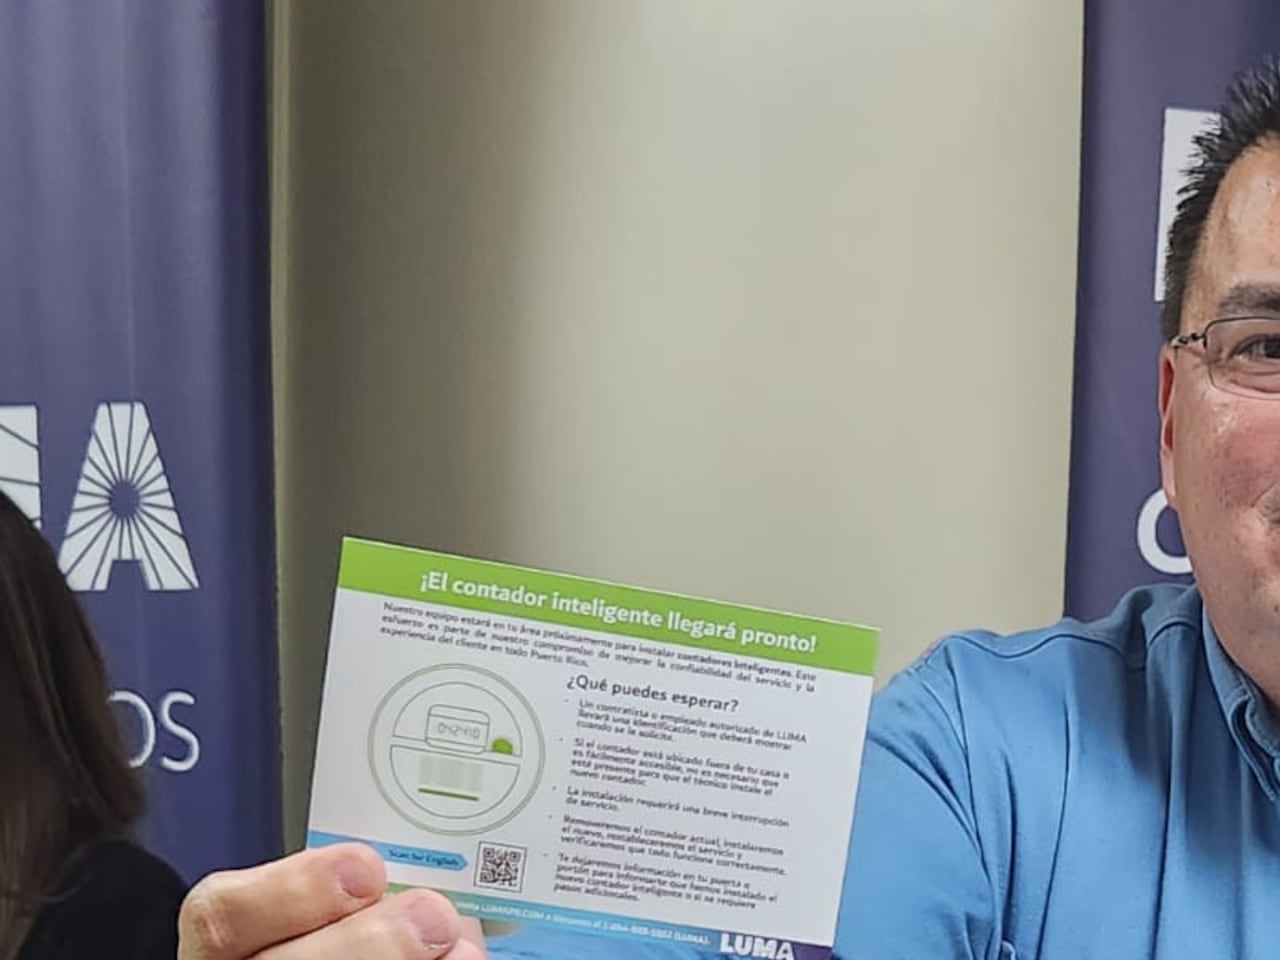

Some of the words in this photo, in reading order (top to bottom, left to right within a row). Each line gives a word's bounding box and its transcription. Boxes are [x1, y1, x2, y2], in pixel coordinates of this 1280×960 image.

[420, 571, 448, 593] ¡El
[452, 580, 544, 607] contador
[551, 591, 662, 627] inteligente
[667, 610, 736, 640] llegará
[740, 629, 817, 653] pronto!
[566, 674, 608, 692] ¿Qué
[611, 683, 667, 701] puedes
[671, 693, 739, 713] esperar?
